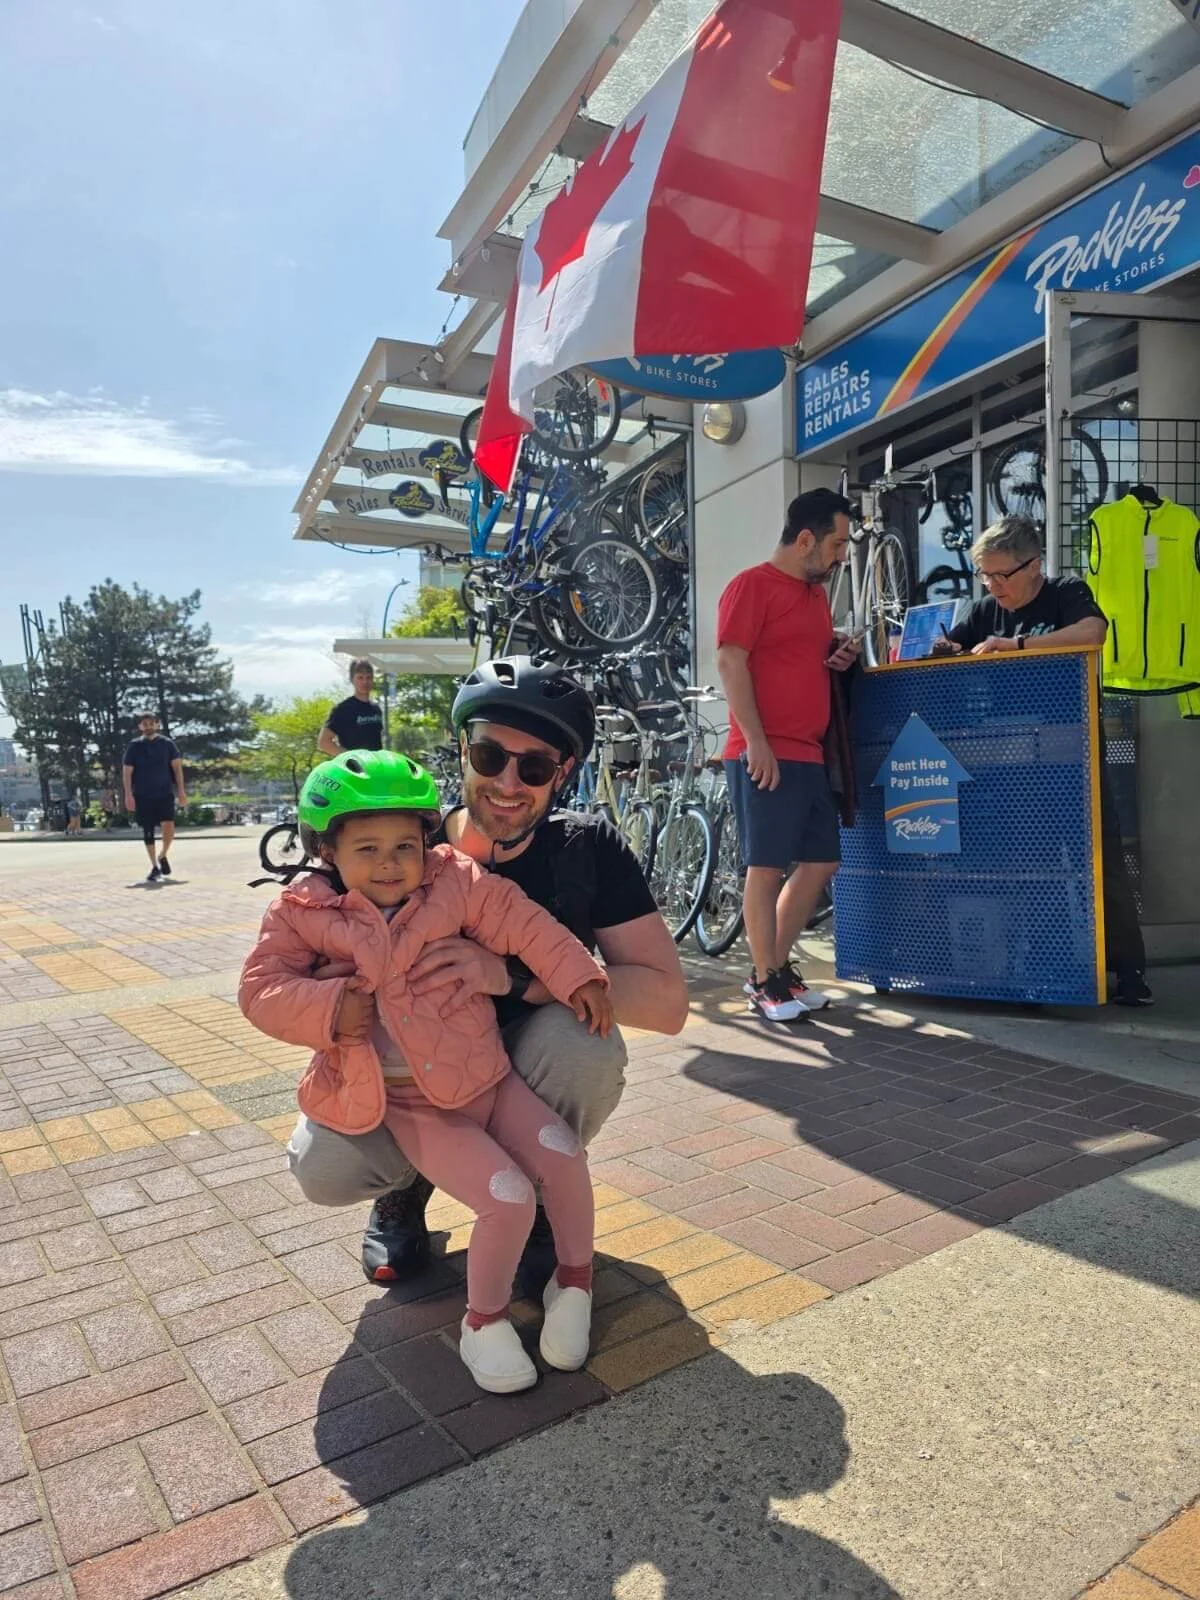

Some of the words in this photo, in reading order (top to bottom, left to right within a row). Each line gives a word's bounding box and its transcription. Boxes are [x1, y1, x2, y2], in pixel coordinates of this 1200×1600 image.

[1024, 182, 1187, 314] Reckless
[1114, 252, 1165, 287] STORES
[646, 364, 672, 379] BIKE
[676, 371, 718, 389] STORES
[804, 360, 849, 400] SALES
[804, 369, 870, 419] REPAIRS
[804, 390, 872, 439] RENTALS
[361, 450, 416, 474] Rentals
[346, 495, 379, 514] Sales
[891, 759, 917, 772] Rent
[919, 757, 948, 770] Here
[890, 777, 910, 790] Pay
[912, 774, 950, 787] Inside
